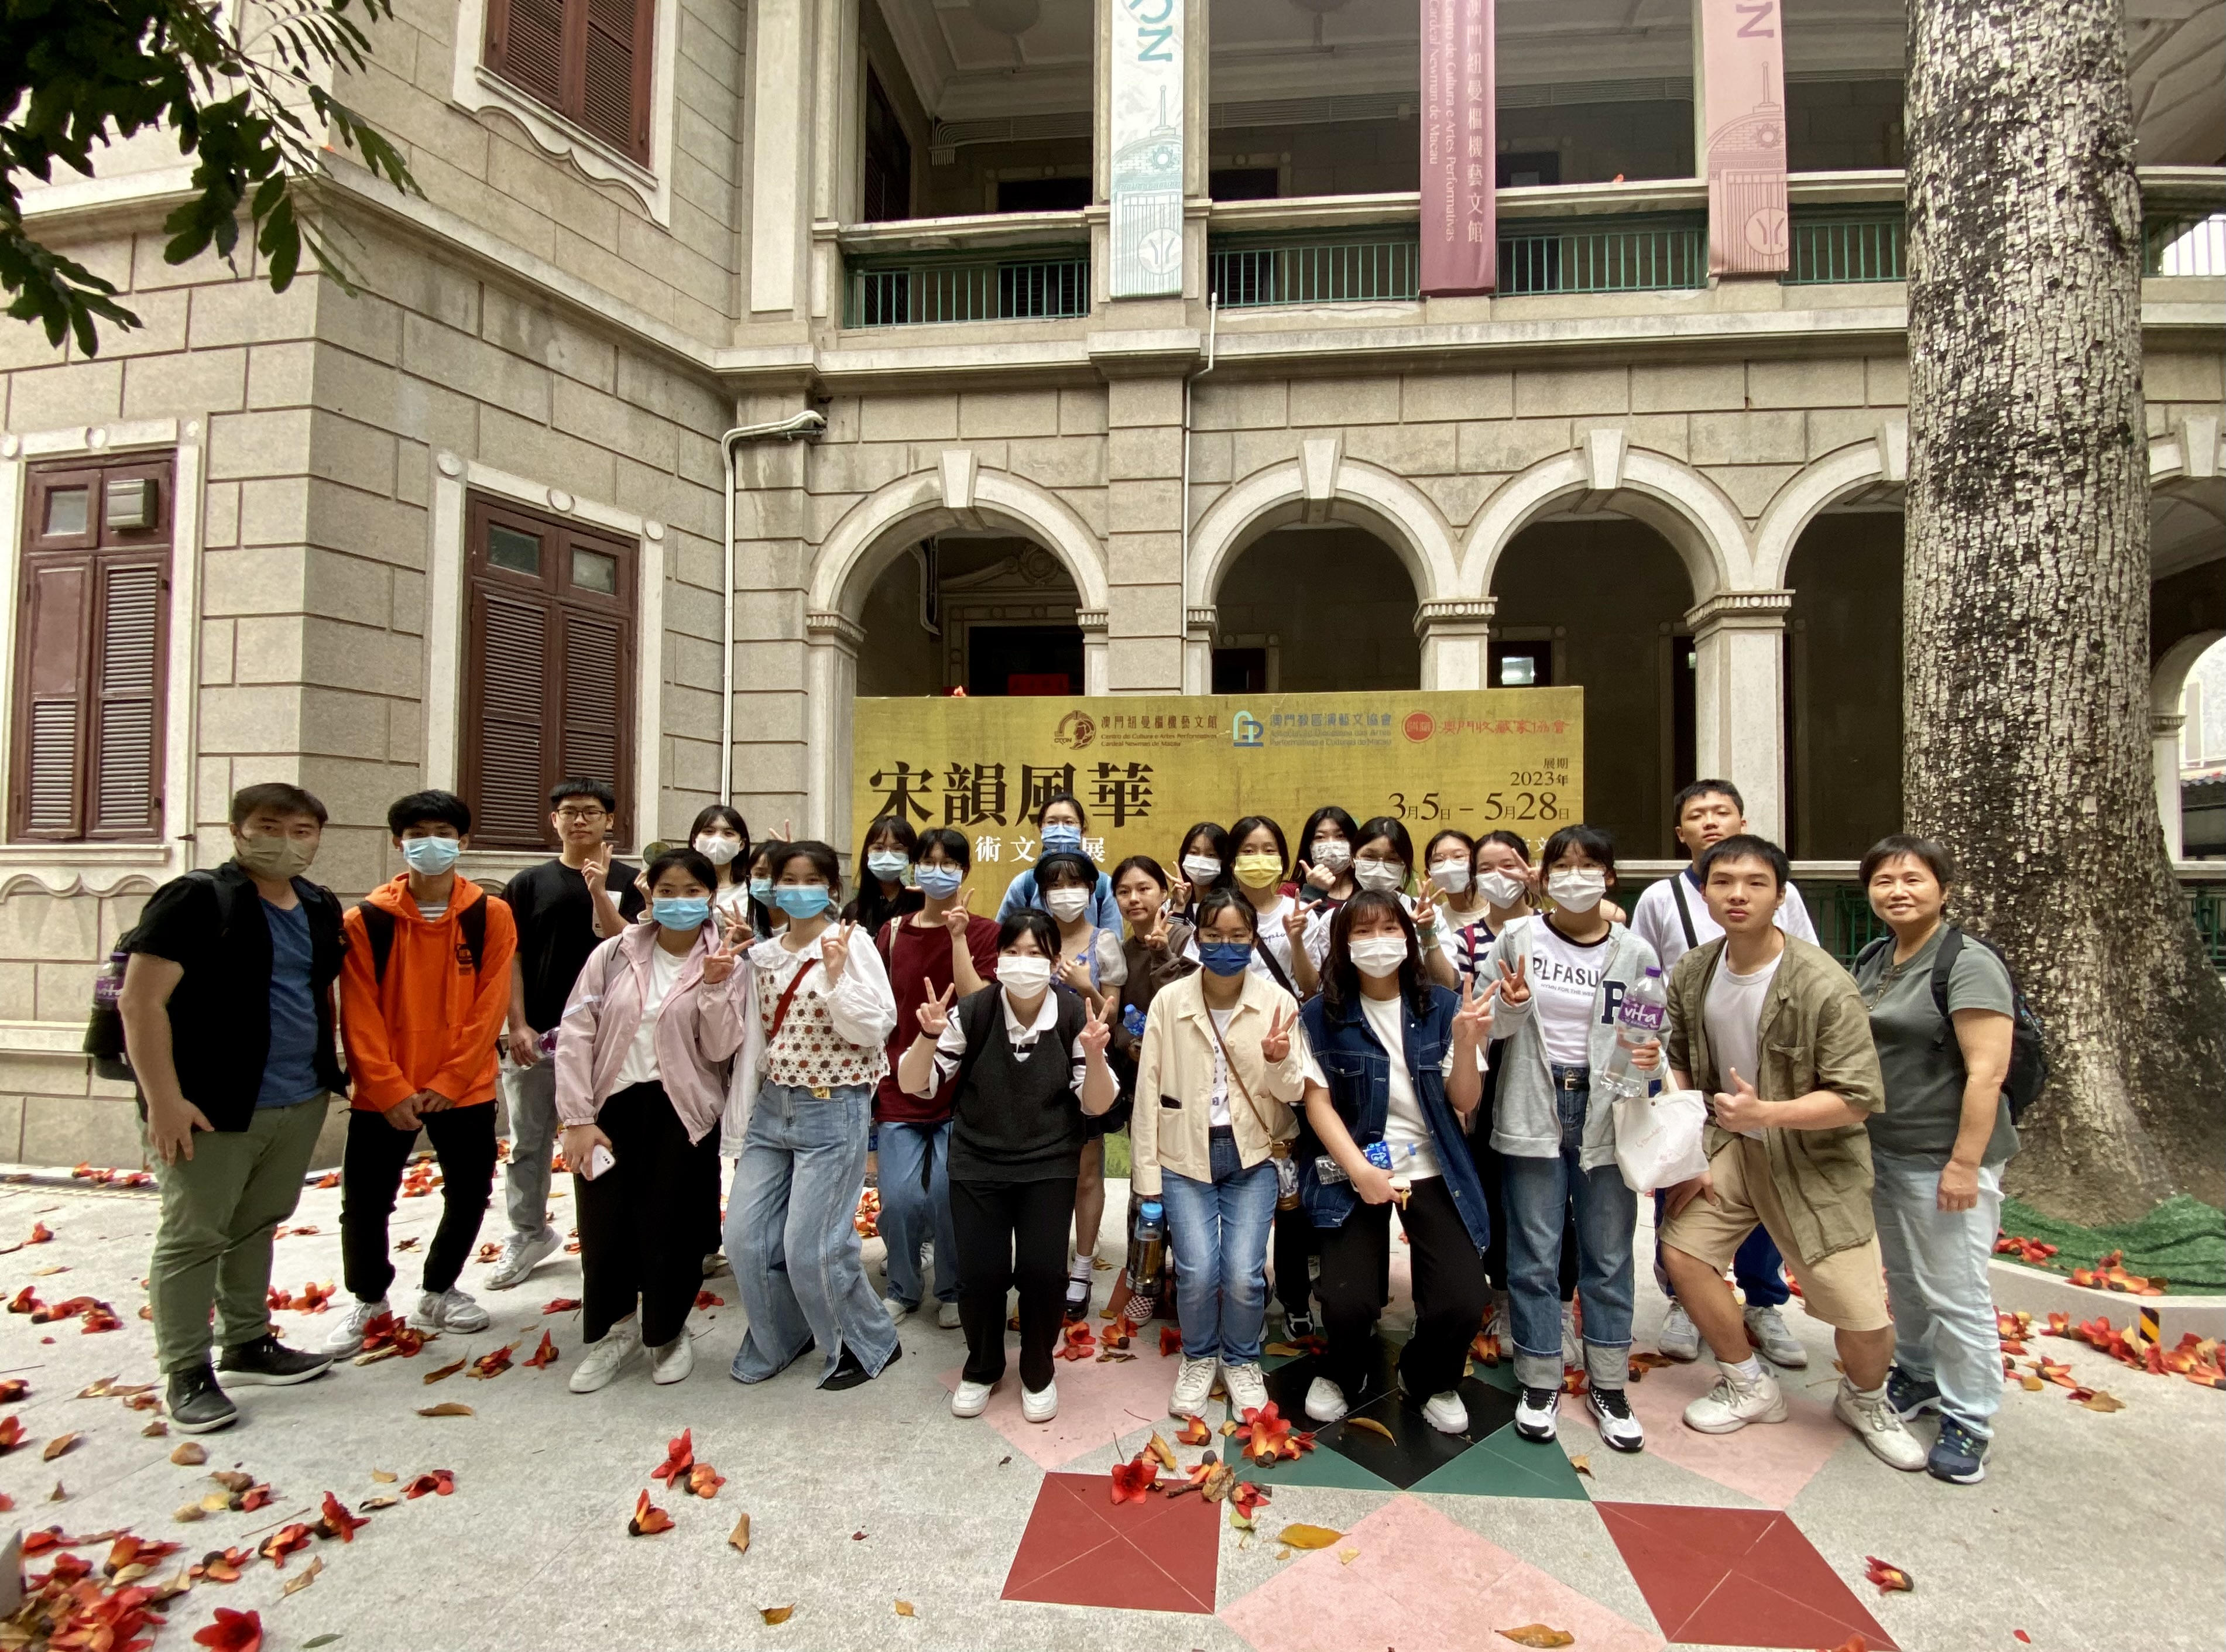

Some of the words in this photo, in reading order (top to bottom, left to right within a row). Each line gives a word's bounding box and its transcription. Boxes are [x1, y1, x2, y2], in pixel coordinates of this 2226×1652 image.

[1429, 0, 1440, 44] Cardeal
[1445, 43, 1457, 58] de
[1429, 49, 1440, 101] Newman
[1445, 62, 1457, 105] Cultura
[1429, 105, 1441, 120] de
[1429, 124, 1440, 164] Macau
[1446, 121, 1456, 153] Artes
[1446, 157, 1458, 242] Performativas
[1510, 772, 1569, 786] 2023年
[1543, 758, 1568, 769] 展期
[1601, 979, 1628, 1024] P
[1624, 1004, 1656, 1024] vita
